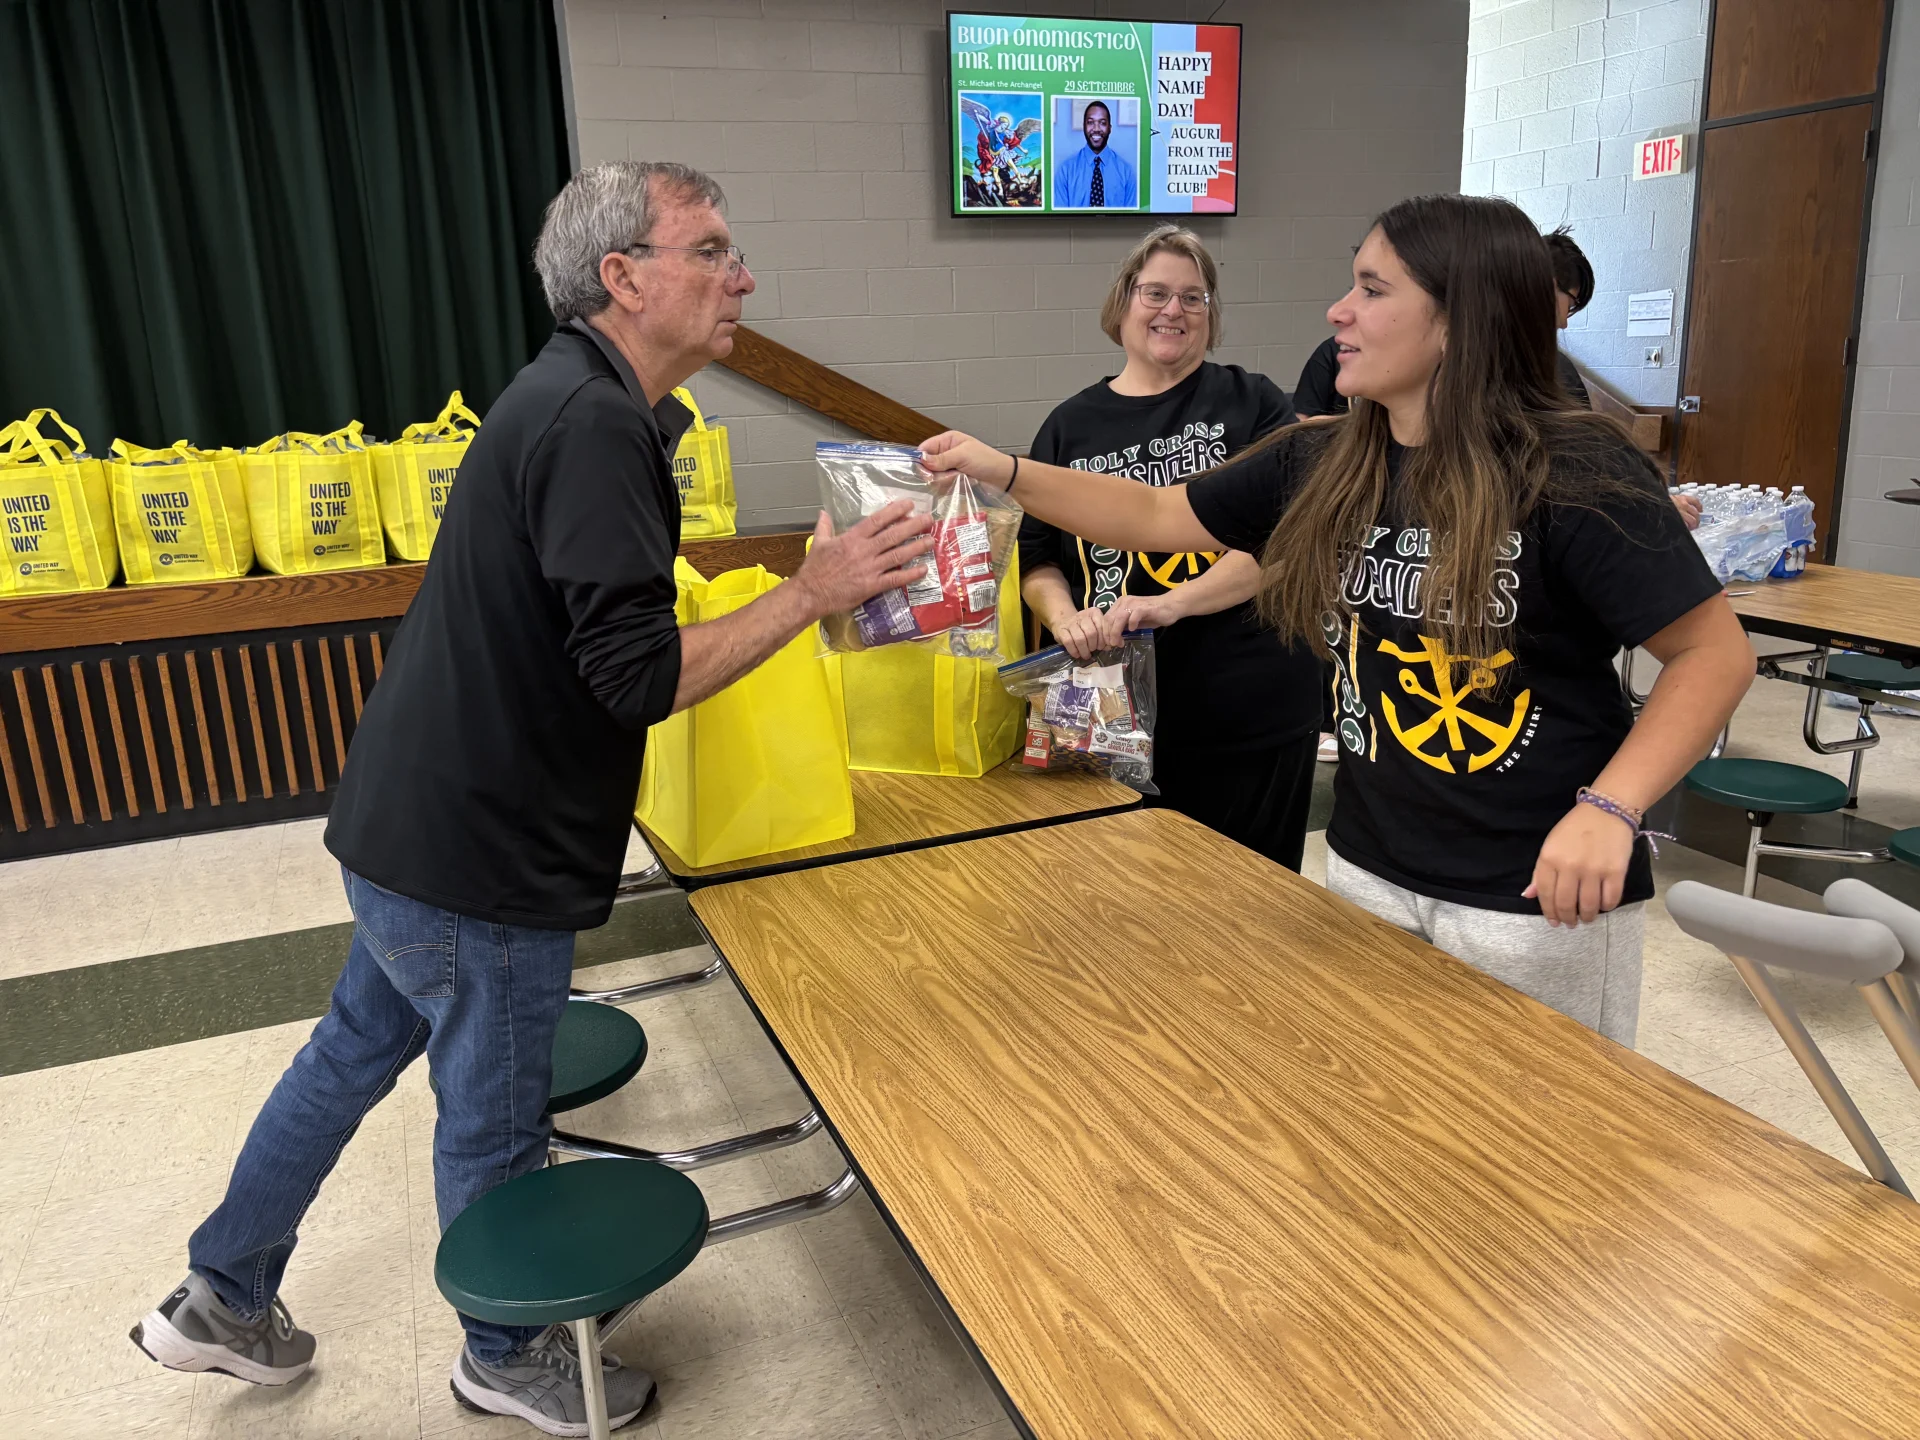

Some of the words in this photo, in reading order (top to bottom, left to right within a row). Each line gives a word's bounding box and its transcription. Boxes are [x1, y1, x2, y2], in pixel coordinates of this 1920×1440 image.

[958, 26, 1009, 46] BUON
[1013, 28, 1136, 50] ONOMASTICO
[958, 51, 993, 70] MR.
[997, 52, 1085, 73] MALLORY!
[1158, 56, 1211, 72] HAPPY
[1010, 81, 1043, 90] Archangel
[1064, 80, 1076, 91] 29
[1076, 81, 1135, 93] SETTEMBRE
[1158, 79, 1205, 95] NAME
[1158, 103, 1193, 117] DAY!
[1171, 127, 1221, 140] AUGURI
[1167, 146, 1204, 158] FROM
[1207, 146, 1233, 158] THE
[1642, 138, 1676, 175] EXIT
[1167, 164, 1219, 176] ITALIAN
[1167, 182, 1207, 193] CLUB!!
[673, 457, 697, 473] ITED
[1070, 444, 1141, 473] HOLY
[428, 467, 459, 484] UNIT
[310, 482, 352, 499] UNITED
[431, 486, 443, 502] IS
[2, 494, 51, 514] UNITED
[142, 491, 190, 509] UNITED
[311, 502, 323, 517] IS
[325, 501, 348, 517] THE
[7, 517, 21, 533] IS
[21, 515, 48, 532] THE
[146, 511, 161, 527] IS
[161, 510, 187, 526] THE
[1495, 751, 1521, 773] THE
[1521, 705, 1543, 747] SHIRT
